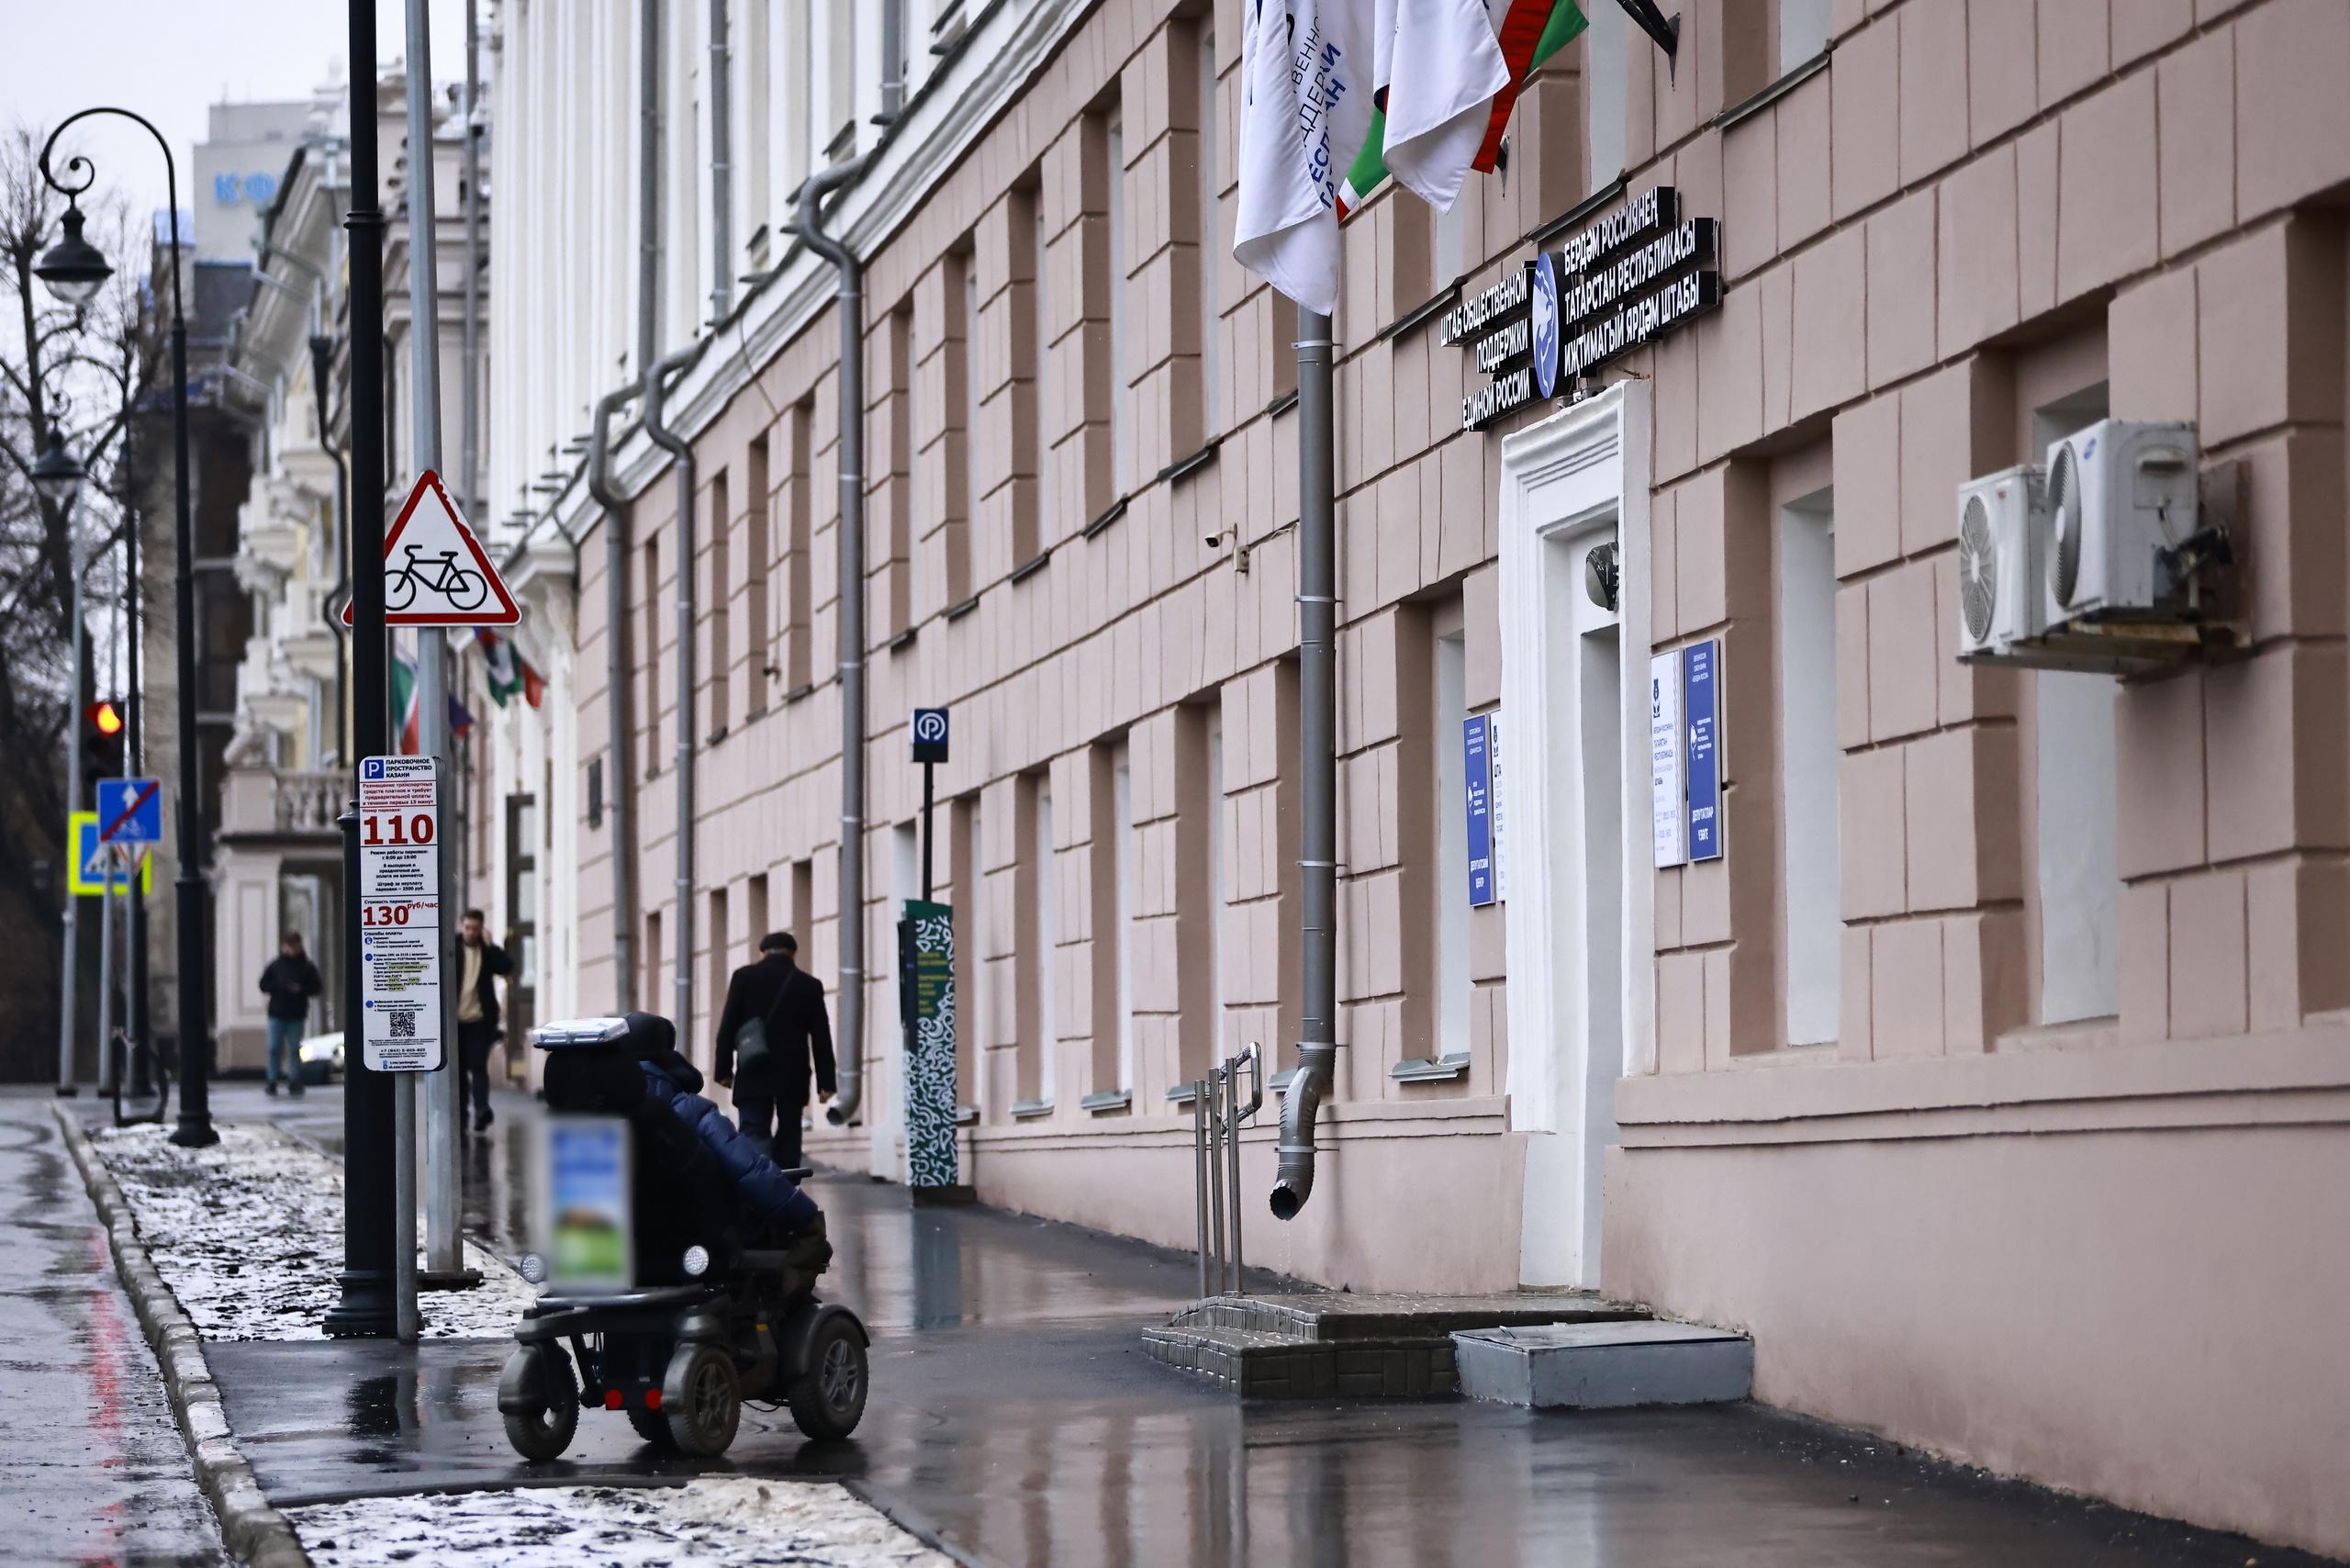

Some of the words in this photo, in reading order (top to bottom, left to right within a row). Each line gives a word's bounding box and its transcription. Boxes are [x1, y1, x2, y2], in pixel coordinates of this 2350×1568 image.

[214, 170, 275, 205] КФ
[1564, 228, 1600, 275] БЕРДӘМ
[1602, 187, 1658, 250] РОССИЯНЕҢ
[1440, 308, 1461, 345] ШТАБ
[1463, 260, 1527, 332] ОБЩЕСТВЕННОЙ
[1565, 269, 1616, 325] ТАТАРСТАН
[1617, 218, 1695, 295] РЕСПУБЛИКАСЫ
[1626, 299, 1659, 342] ЯРДӘМ
[1661, 271, 1699, 324] ШТАБЫ
[1477, 318, 1528, 373] ПОДДЕРЖКИ
[1463, 374, 1494, 431] ЕДИНОЙ
[1495, 367, 1529, 412] РОССИИ
[364, 814, 434, 845] 110
[363, 905, 409, 926] 130
[408, 902, 440, 910] руб/час
